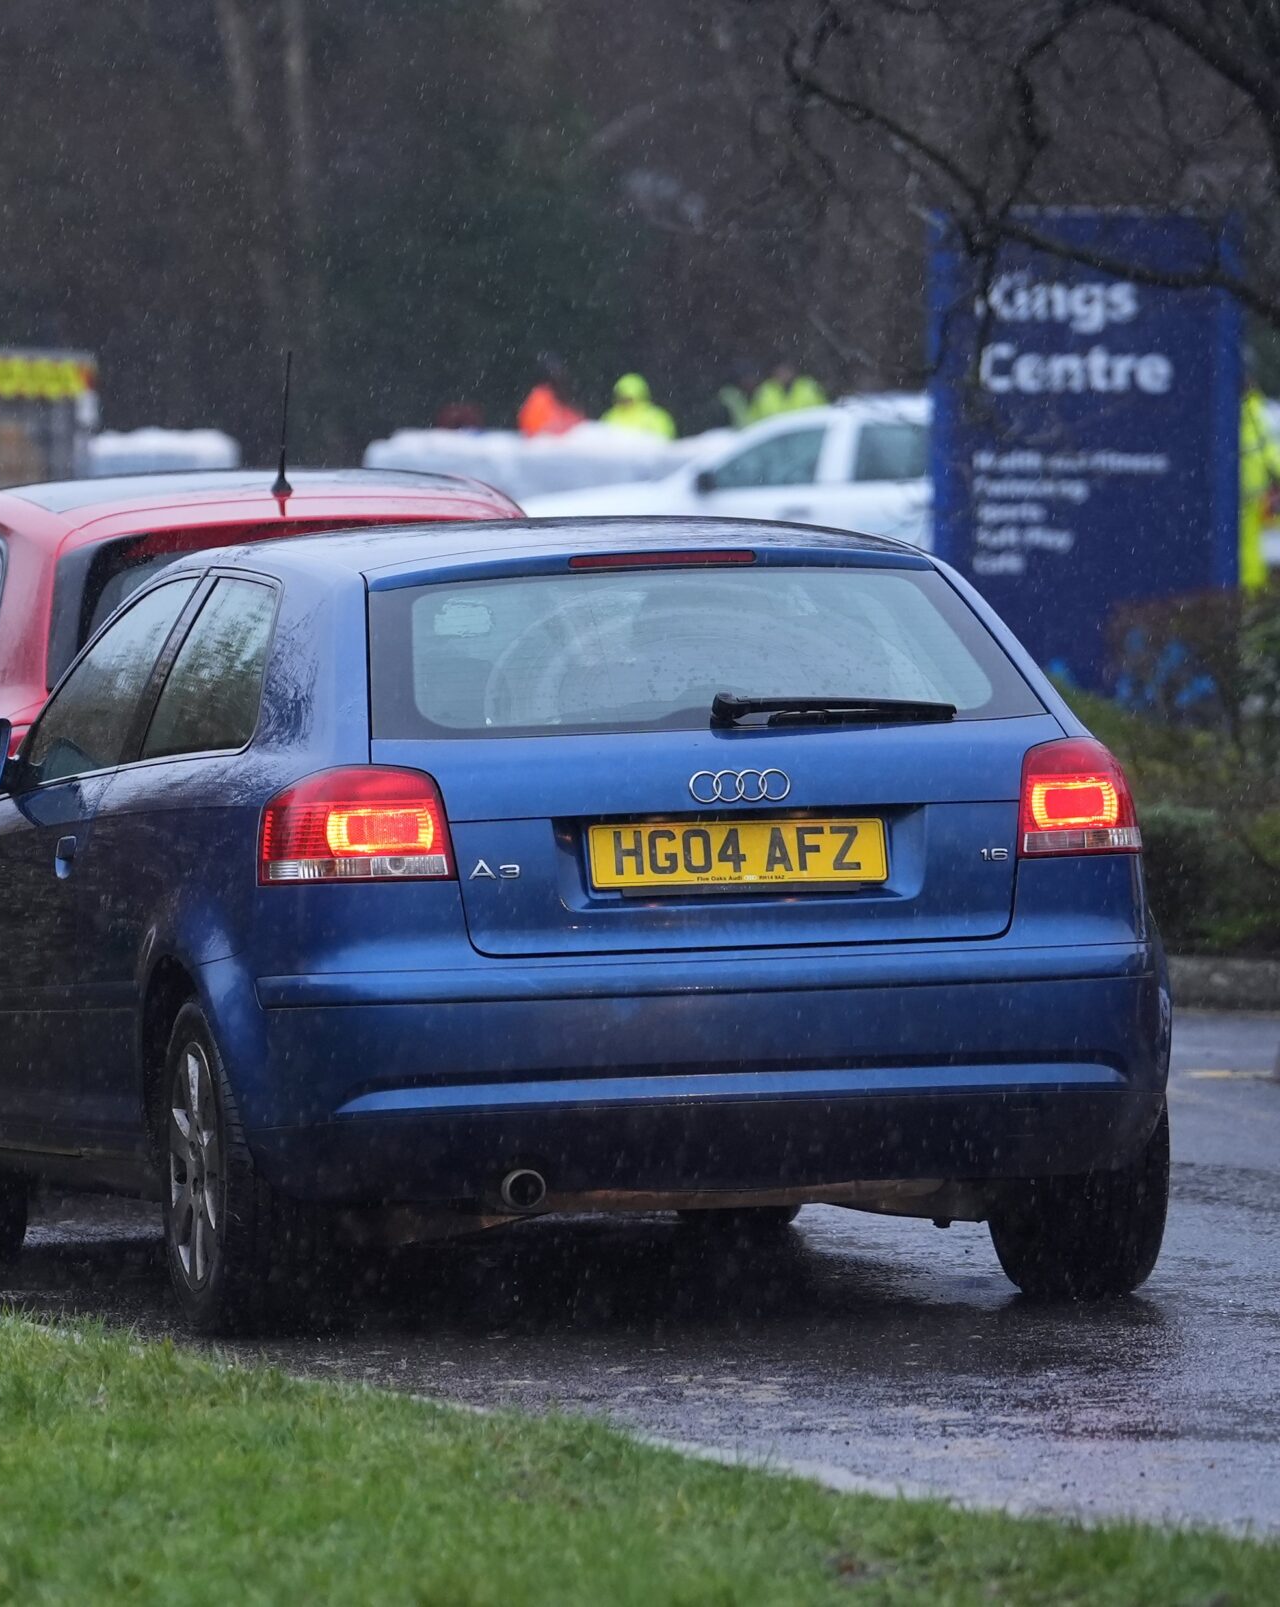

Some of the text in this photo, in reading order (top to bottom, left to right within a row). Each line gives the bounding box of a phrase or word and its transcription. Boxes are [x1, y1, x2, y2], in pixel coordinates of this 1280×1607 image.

[979, 342, 1175, 394] Centre
[468, 859, 521, 880] A3
[614, 826, 861, 875] HG04 AFZ
